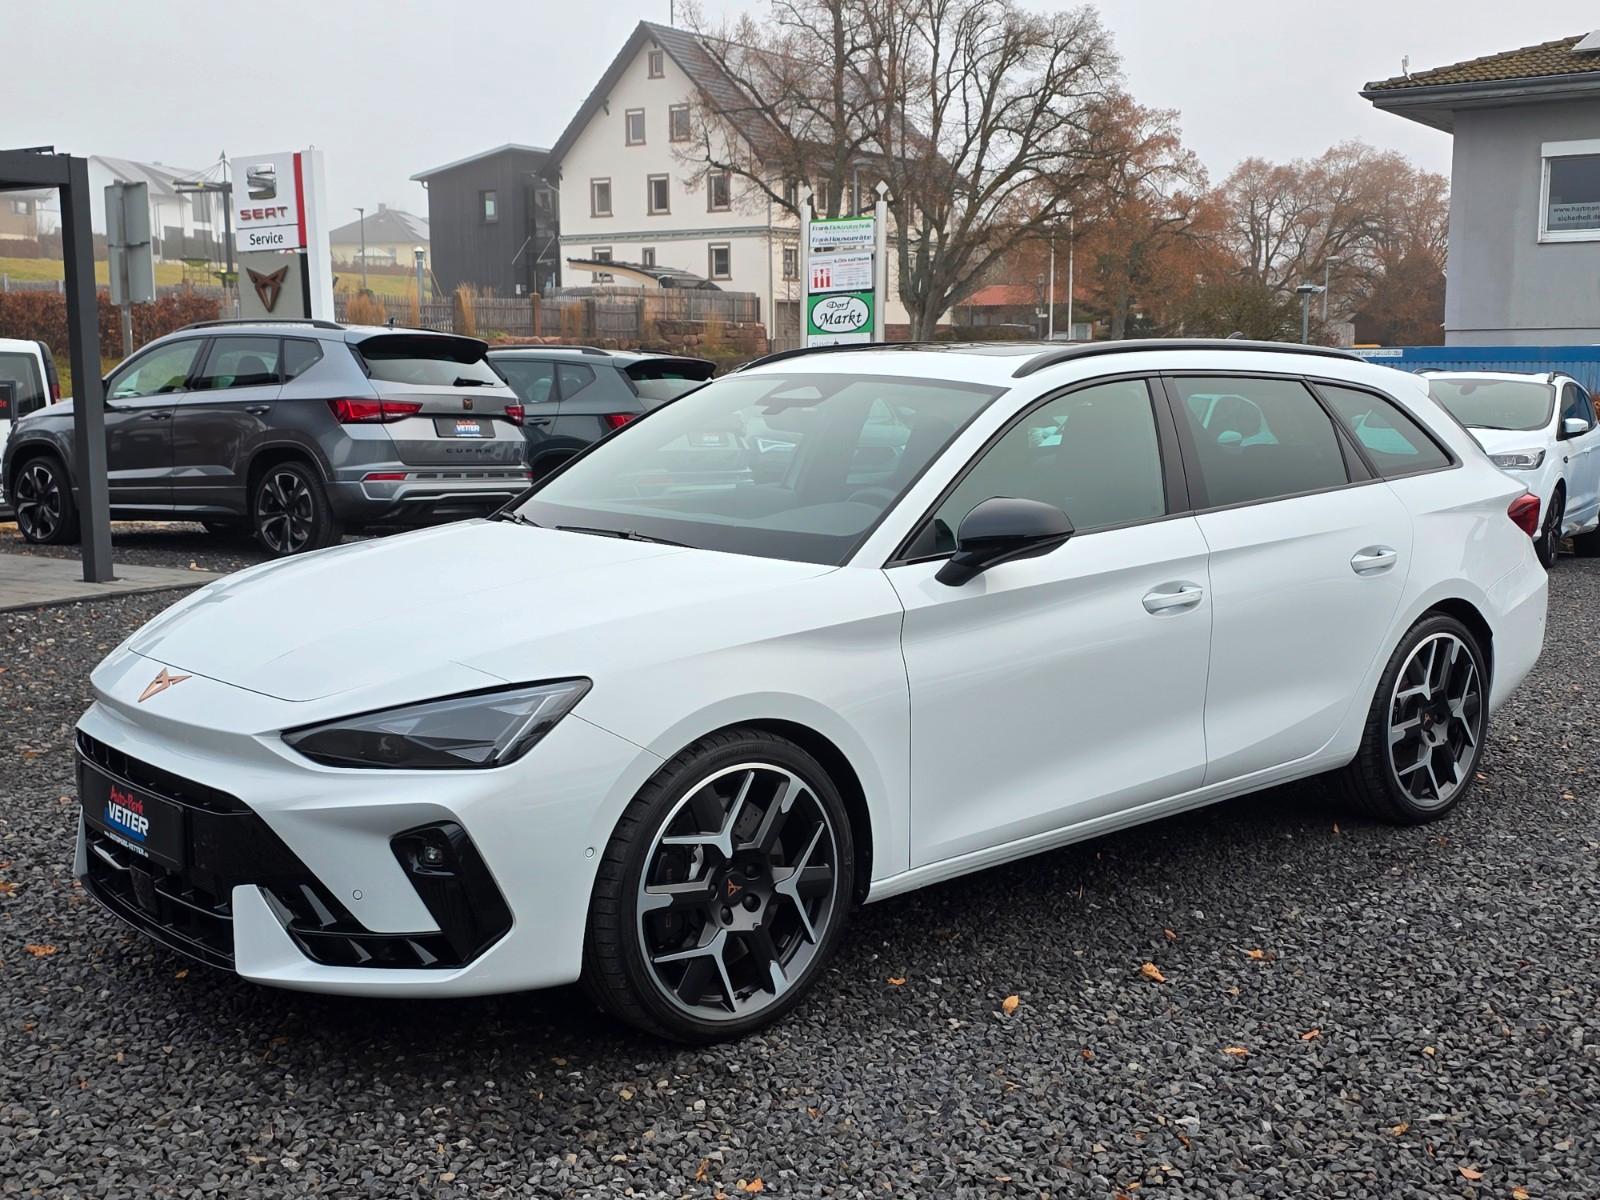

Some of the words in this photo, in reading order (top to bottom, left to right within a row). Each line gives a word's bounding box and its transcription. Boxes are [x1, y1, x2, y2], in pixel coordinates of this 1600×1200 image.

[240, 206, 288, 220] SEAT
[249, 232, 283, 245] Service
[827, 298, 852, 310] Dorf
[820, 309, 862, 327] Markt
[108, 800, 149, 836] VETTER
